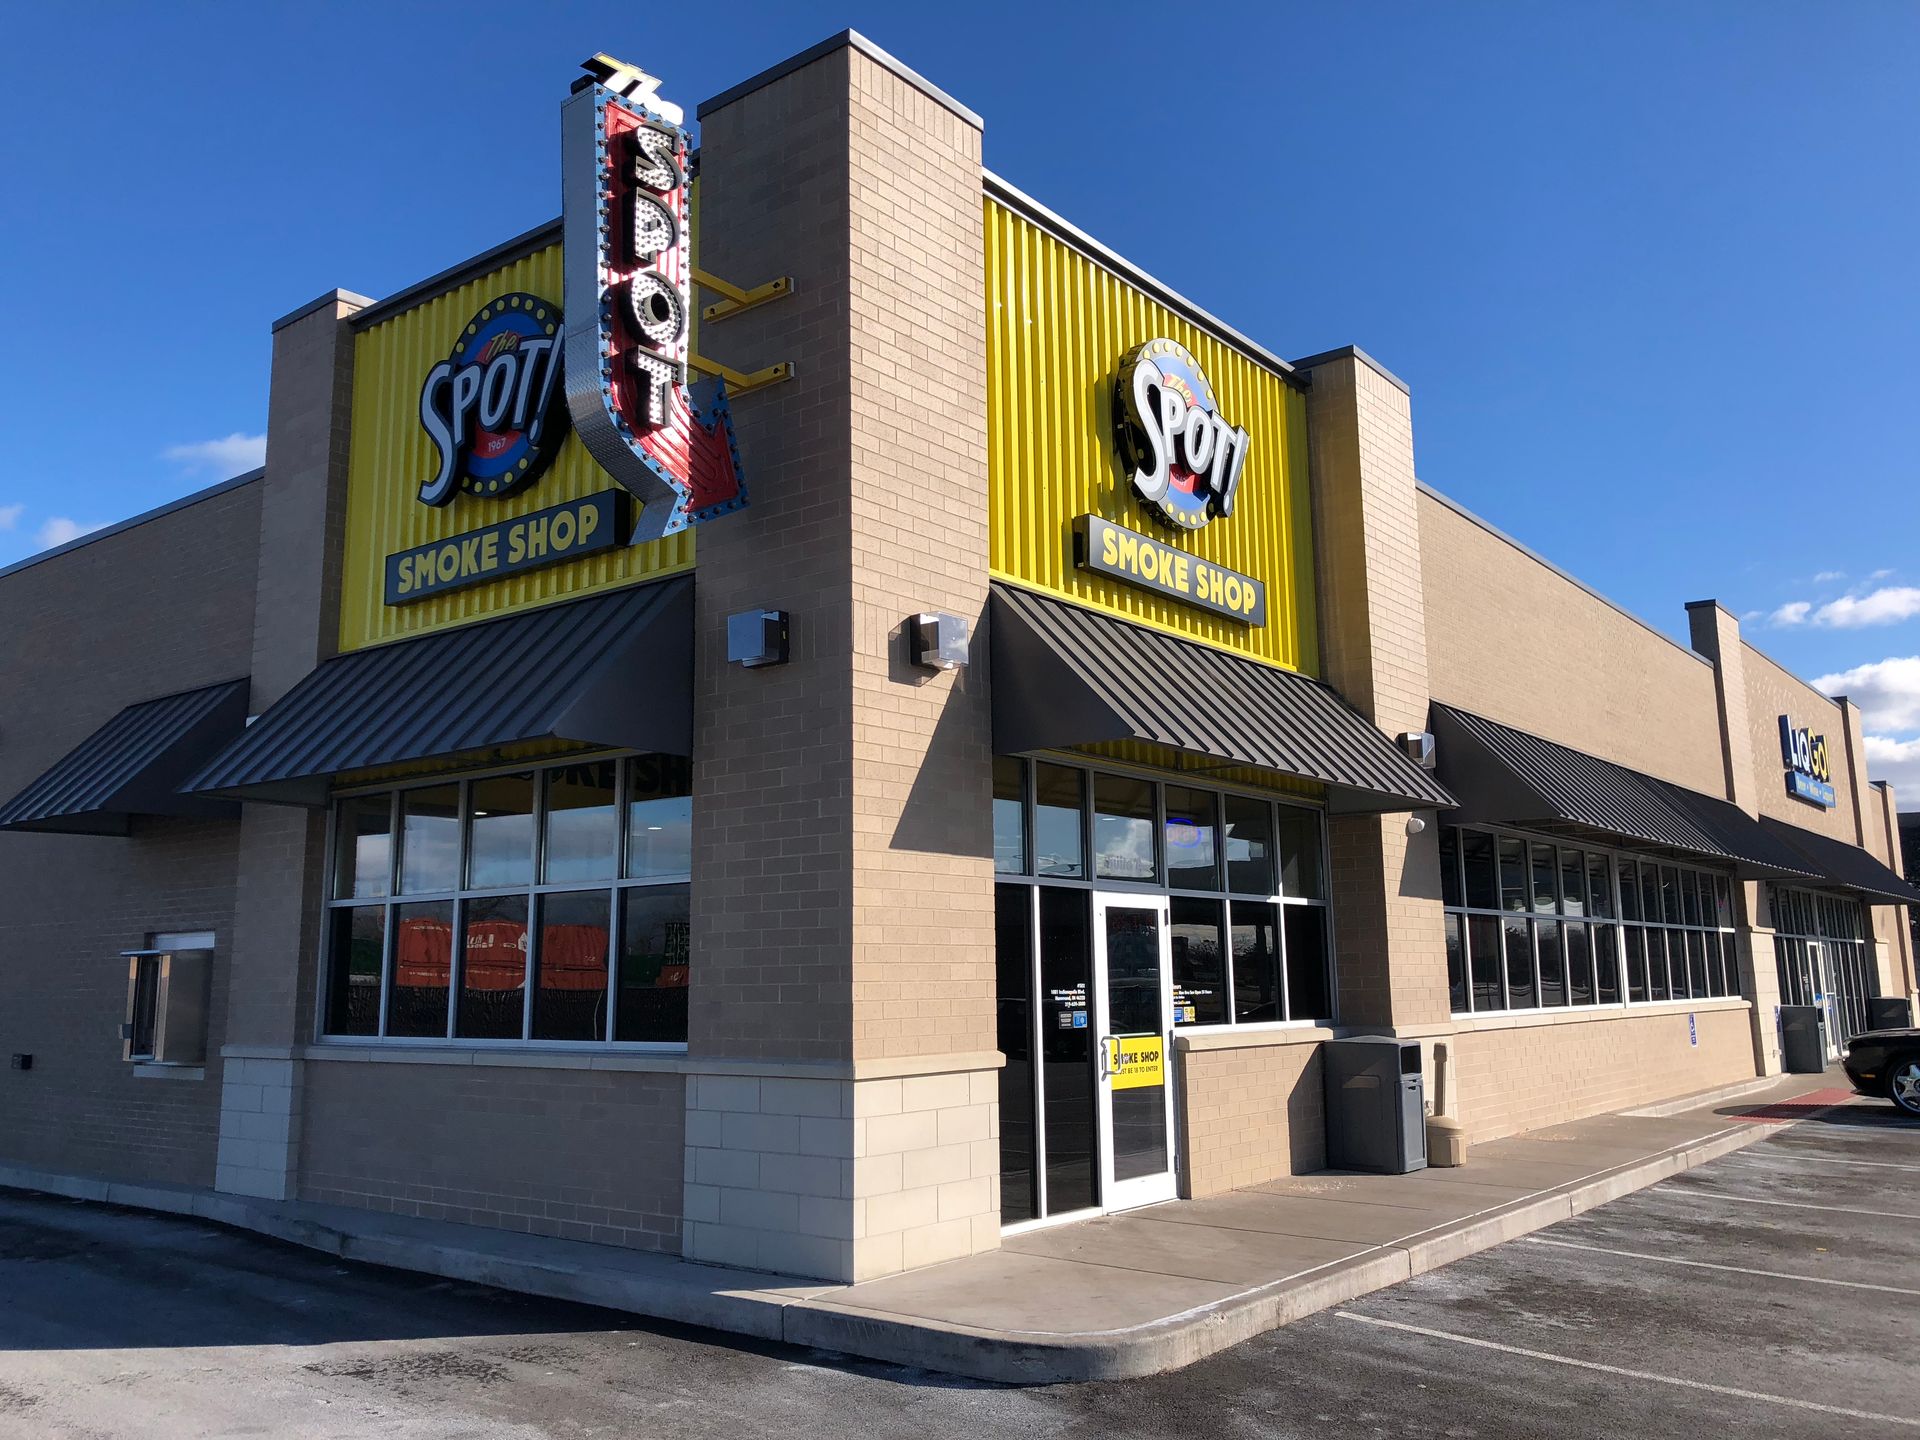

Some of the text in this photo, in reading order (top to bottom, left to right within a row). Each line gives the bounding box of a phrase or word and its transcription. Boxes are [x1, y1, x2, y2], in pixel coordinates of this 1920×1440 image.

[631, 121, 684, 428] SPOT
[419, 323, 564, 501] SPOT!
[487, 437, 506, 453] 1967
[1132, 358, 1251, 518] SPOT!
[397, 503, 599, 595] SMOKE SHOP
[1102, 527, 1257, 616] SMOKE SHOP
[1140, 1050, 1159, 1063] SHOP
